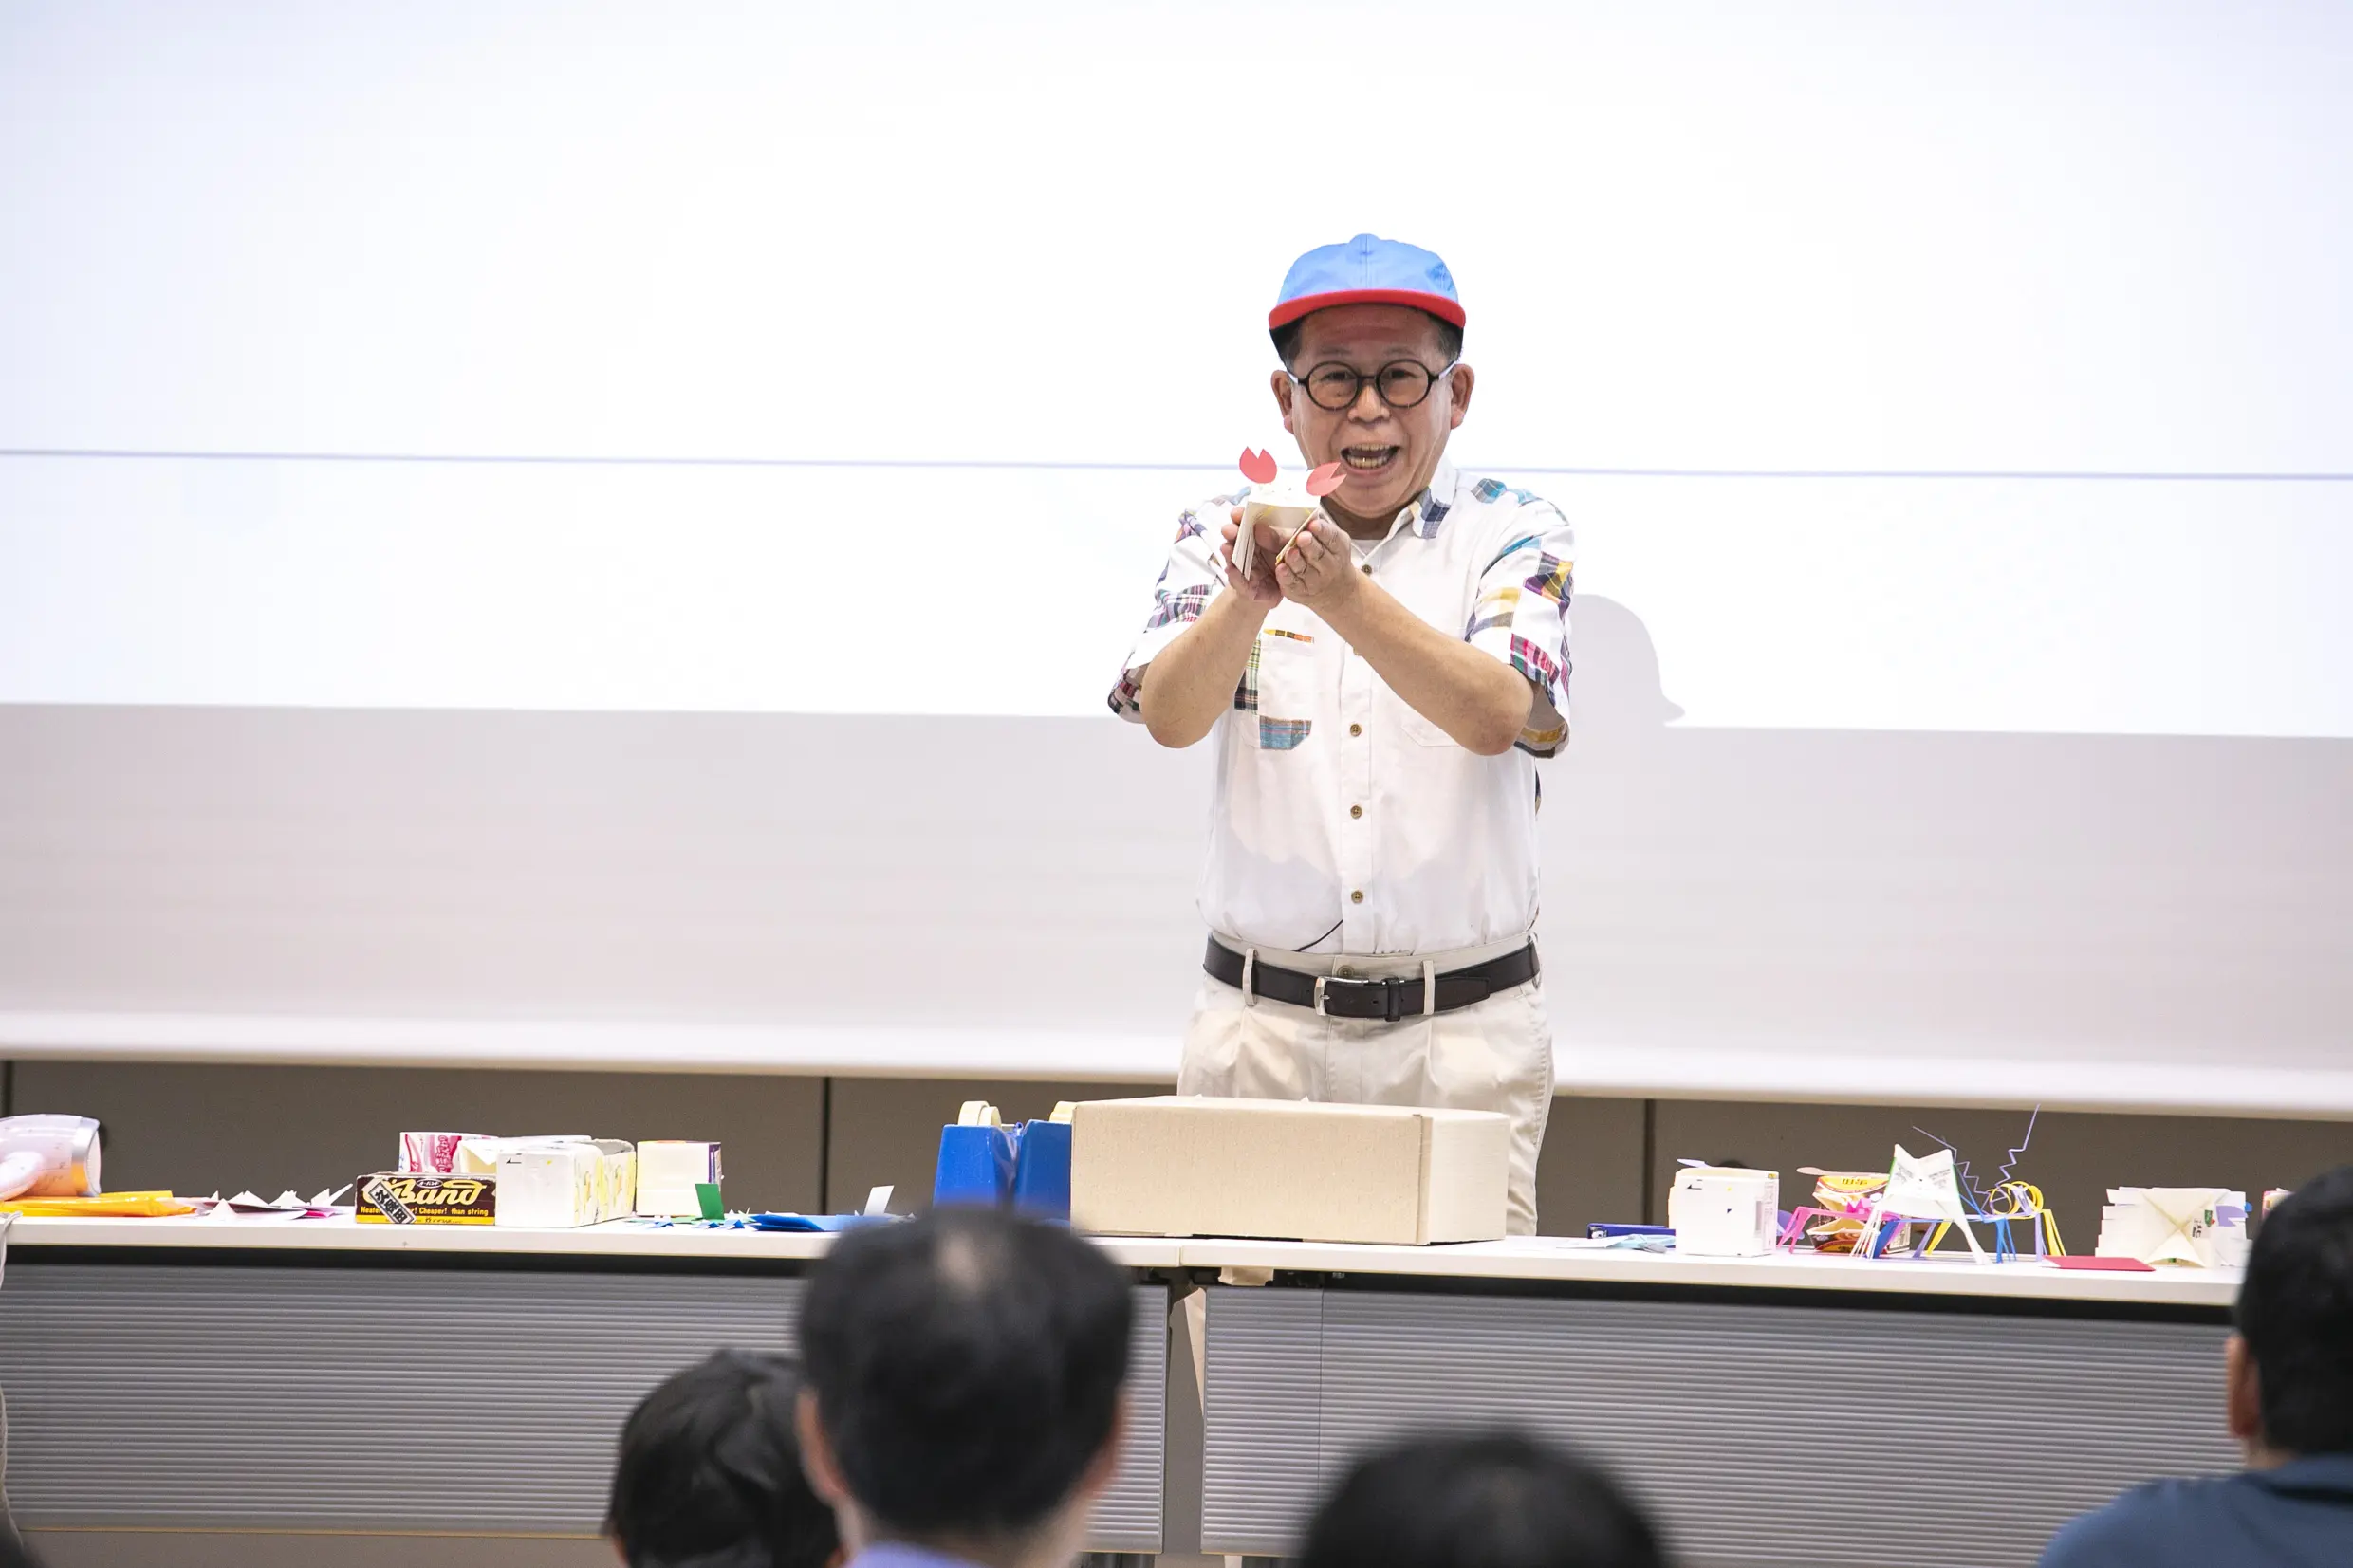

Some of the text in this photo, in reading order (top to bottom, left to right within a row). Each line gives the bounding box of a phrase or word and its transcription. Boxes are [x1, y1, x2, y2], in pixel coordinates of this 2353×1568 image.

[374, 1189, 408, 1224] 久保田
[419, 1207, 447, 1215] Cheaper!
[451, 1207, 465, 1215] than
[468, 1208, 489, 1216] string
